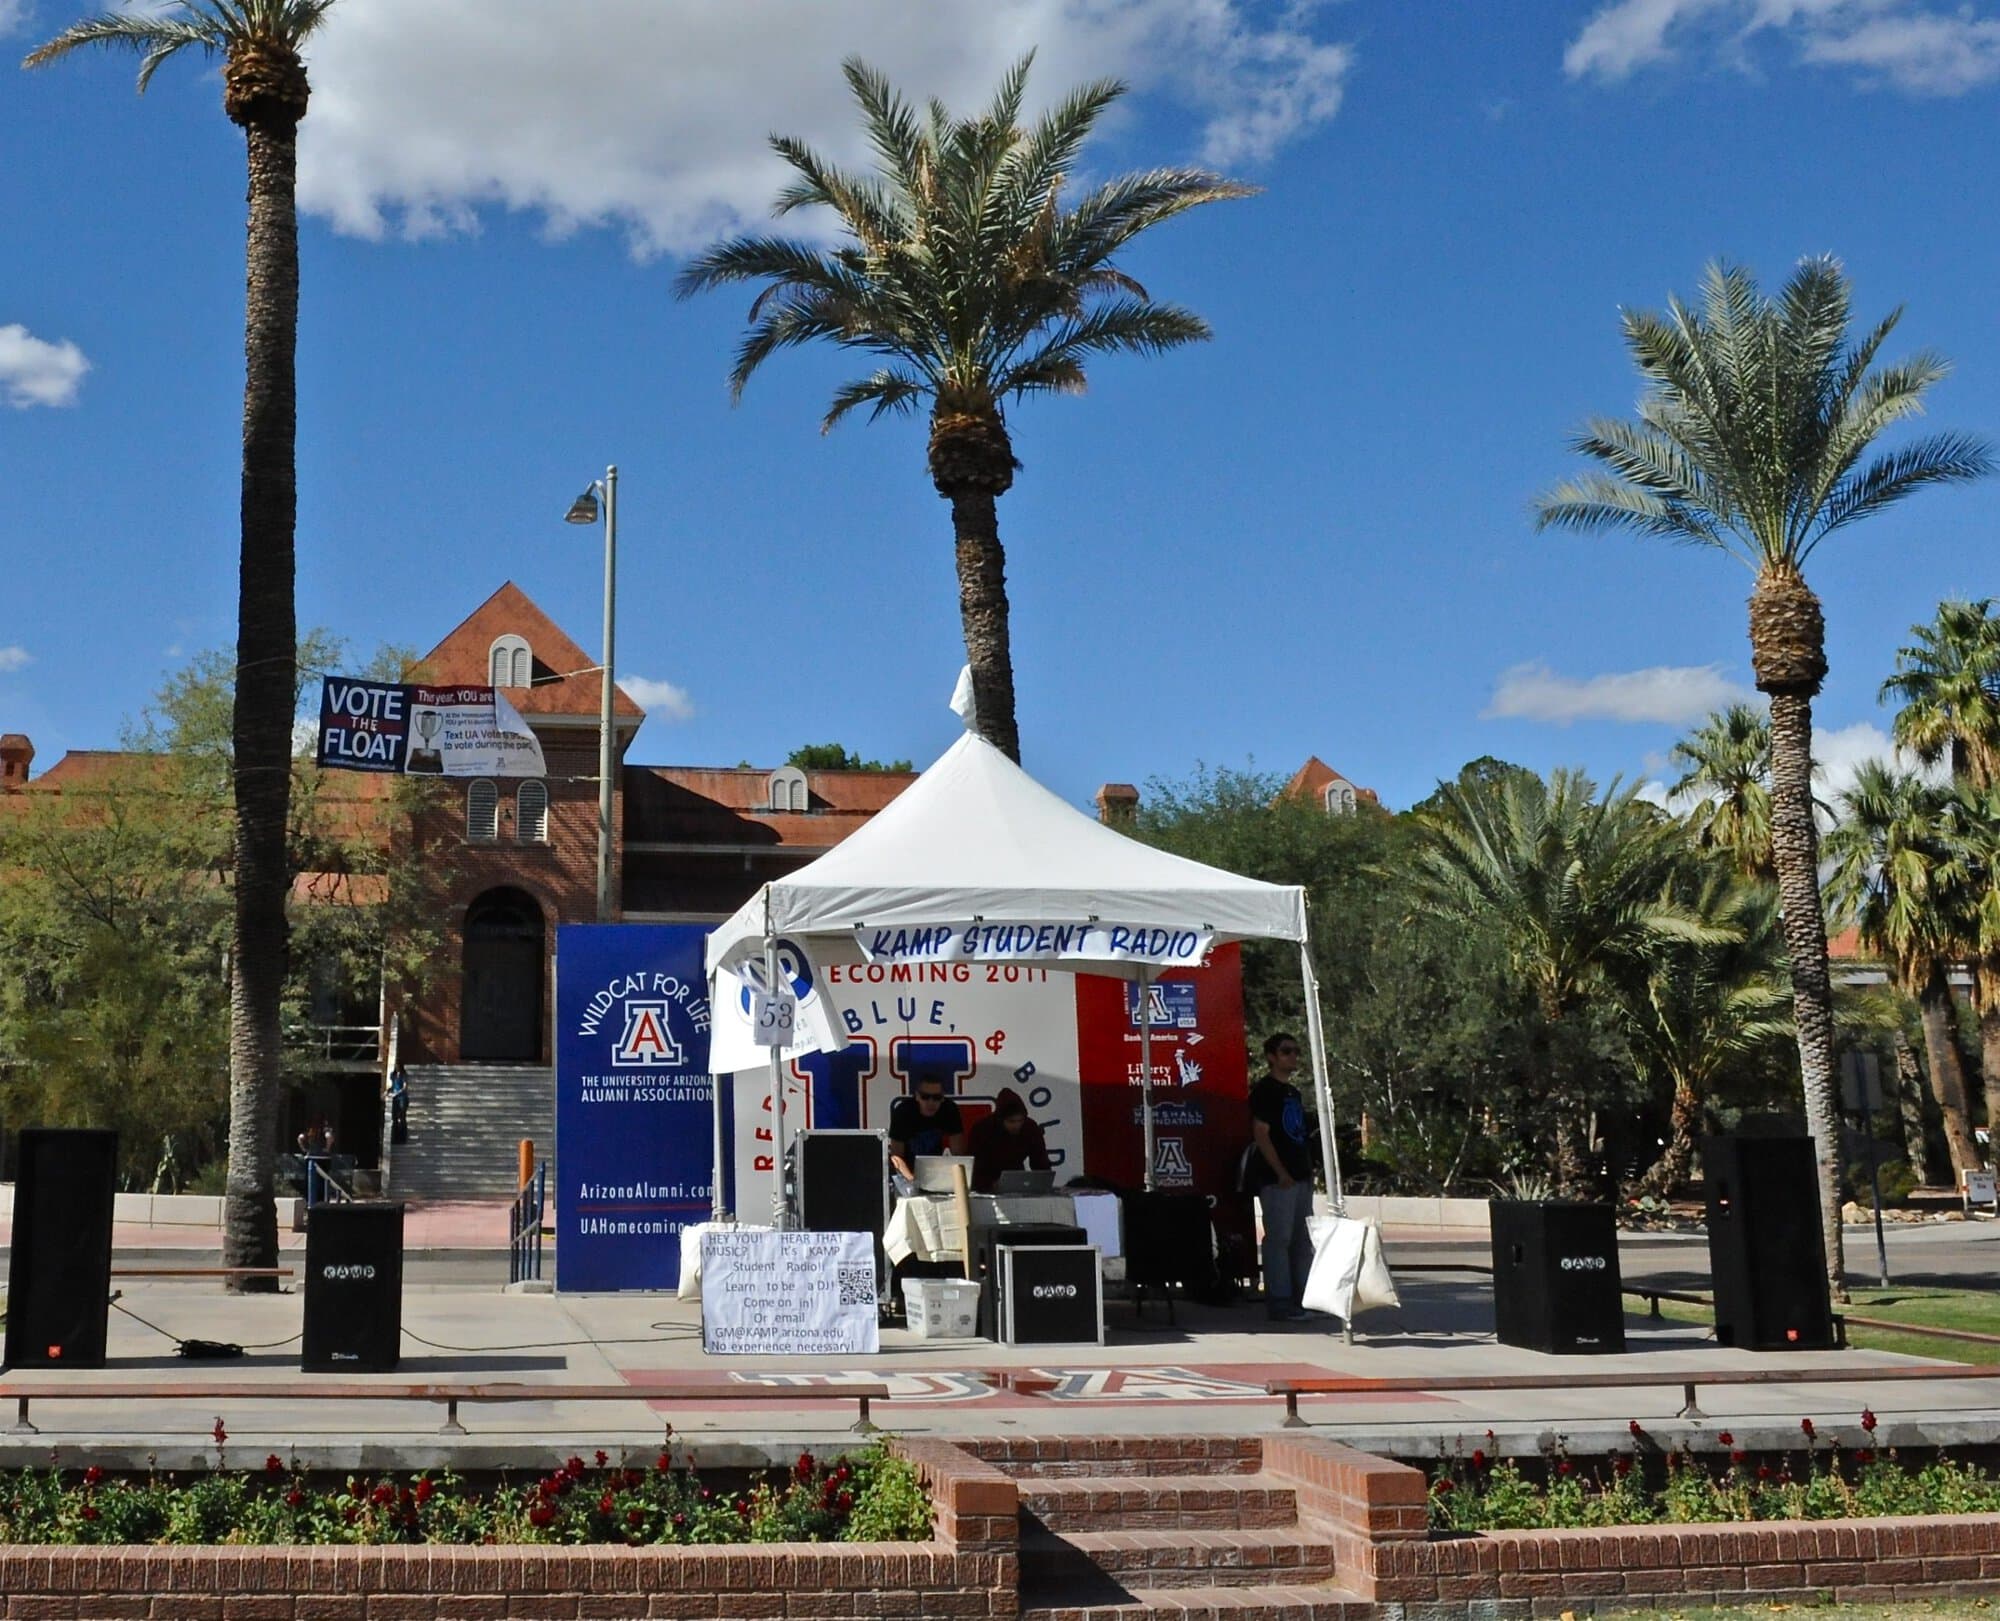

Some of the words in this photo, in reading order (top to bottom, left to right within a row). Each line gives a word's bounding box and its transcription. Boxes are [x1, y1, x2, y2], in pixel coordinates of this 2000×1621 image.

[328, 684, 404, 720] VOTE
[457, 690, 477, 702] YOU
[351, 716, 378, 732] THE
[445, 731, 463, 740] Text
[464, 731, 479, 740] UA
[325, 728, 402, 761] FLOAT
[444, 742, 453, 750] to
[454, 741, 473, 750] vote
[475, 740, 503, 751] during
[870, 926, 953, 957] KAMP
[962, 924, 1095, 954] STUDENT
[1109, 925, 1198, 958] RADIO
[829, 963, 971, 983] ECOMING
[986, 964, 1047, 983] 2011
[578, 972, 647, 1036] WILDCAT
[653, 972, 690, 1004] FOR
[686, 998, 712, 1034] LIFE
[760, 1002, 792, 1029] 53
[841, 997, 956, 1034] BLUE,
[612, 1000, 682, 1067] A
[985, 1030, 1006, 1055] &
[581, 1076, 599, 1087] THE
[602, 1075, 656, 1087] UNIVERSITY
[659, 1075, 671, 1086] OF
[673, 1075, 713, 1086] ARIZONA
[1128, 1075, 1172, 1087] Mual
[581, 1088, 629, 1102] ALUMNI
[633, 1087, 713, 1102] ASSOCIATION
[1013, 1061, 1065, 1167] BOLD
[709, 1234, 729, 1244] HEY
[735, 1234, 762, 1244] YOU!
[780, 1234, 811, 1244] HEAR
[816, 1234, 843, 1244] THAT
[705, 1247, 748, 1257] MUSIC?
[809, 1246, 840, 1257] KAMP
[733, 1262, 775, 1272] Student
[726, 1282, 755, 1292] Learn
[767, 1282, 779, 1291] to
[781, 1281, 795, 1291] be
[808, 1283, 815, 1291] a
[817, 1281, 834, 1291] DJ!
[743, 1298, 774, 1308] Come
[778, 1299, 792, 1308] on
[754, 1313, 767, 1324] Or
[774, 1313, 805, 1324] email
[712, 1342, 726, 1351] No
[731, 1342, 791, 1354] experience
[797, 1341, 854, 1354] necessary!
